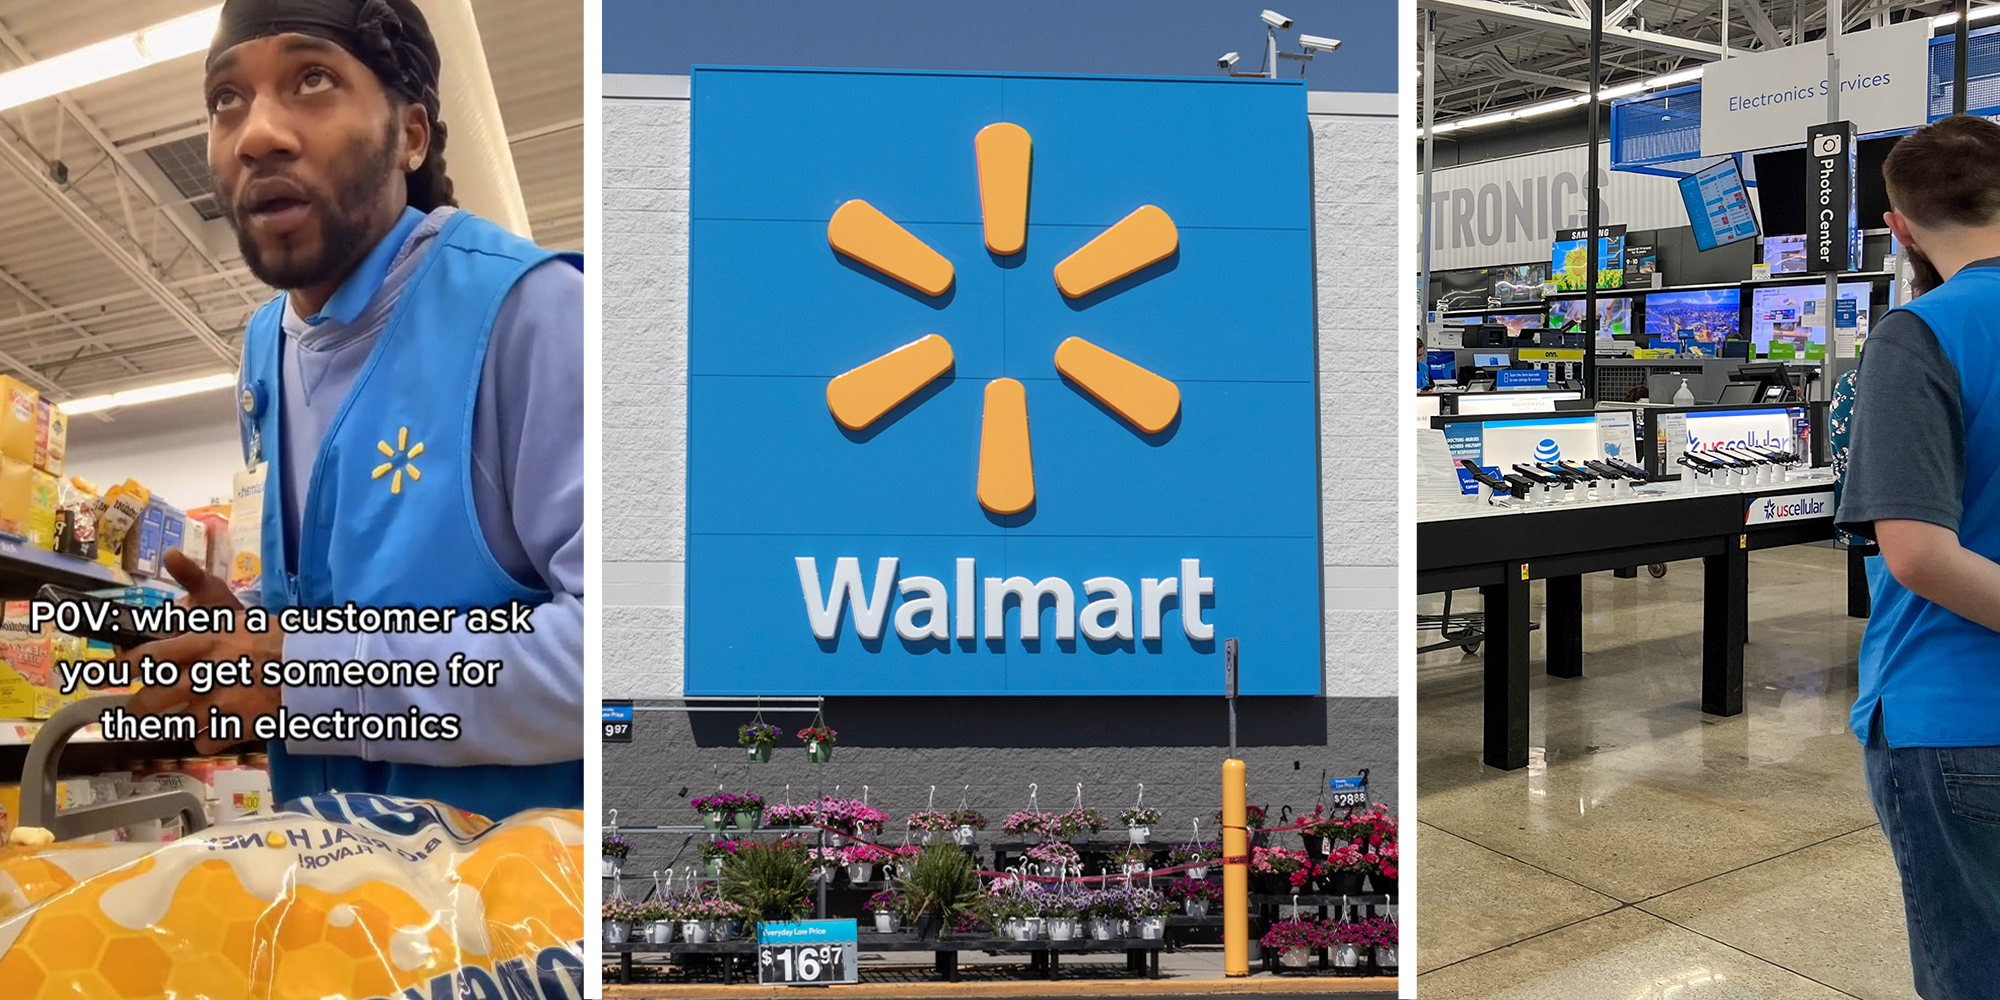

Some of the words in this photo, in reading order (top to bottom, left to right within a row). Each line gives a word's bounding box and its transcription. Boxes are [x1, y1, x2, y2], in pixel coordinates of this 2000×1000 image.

[1729, 86, 1814, 112] Electronics
[1819, 73, 1891, 96] Srvices
[1820, 158, 1834, 205] Photo
[1571, 229, 1609, 240] SAMNG
[1820, 208, 1834, 263] Center
[1776, 498, 1825, 518] uscellular
[795, 556, 1214, 641] Walmart
[763, 928, 793, 937] Everyday
[808, 927, 826, 935] Price
